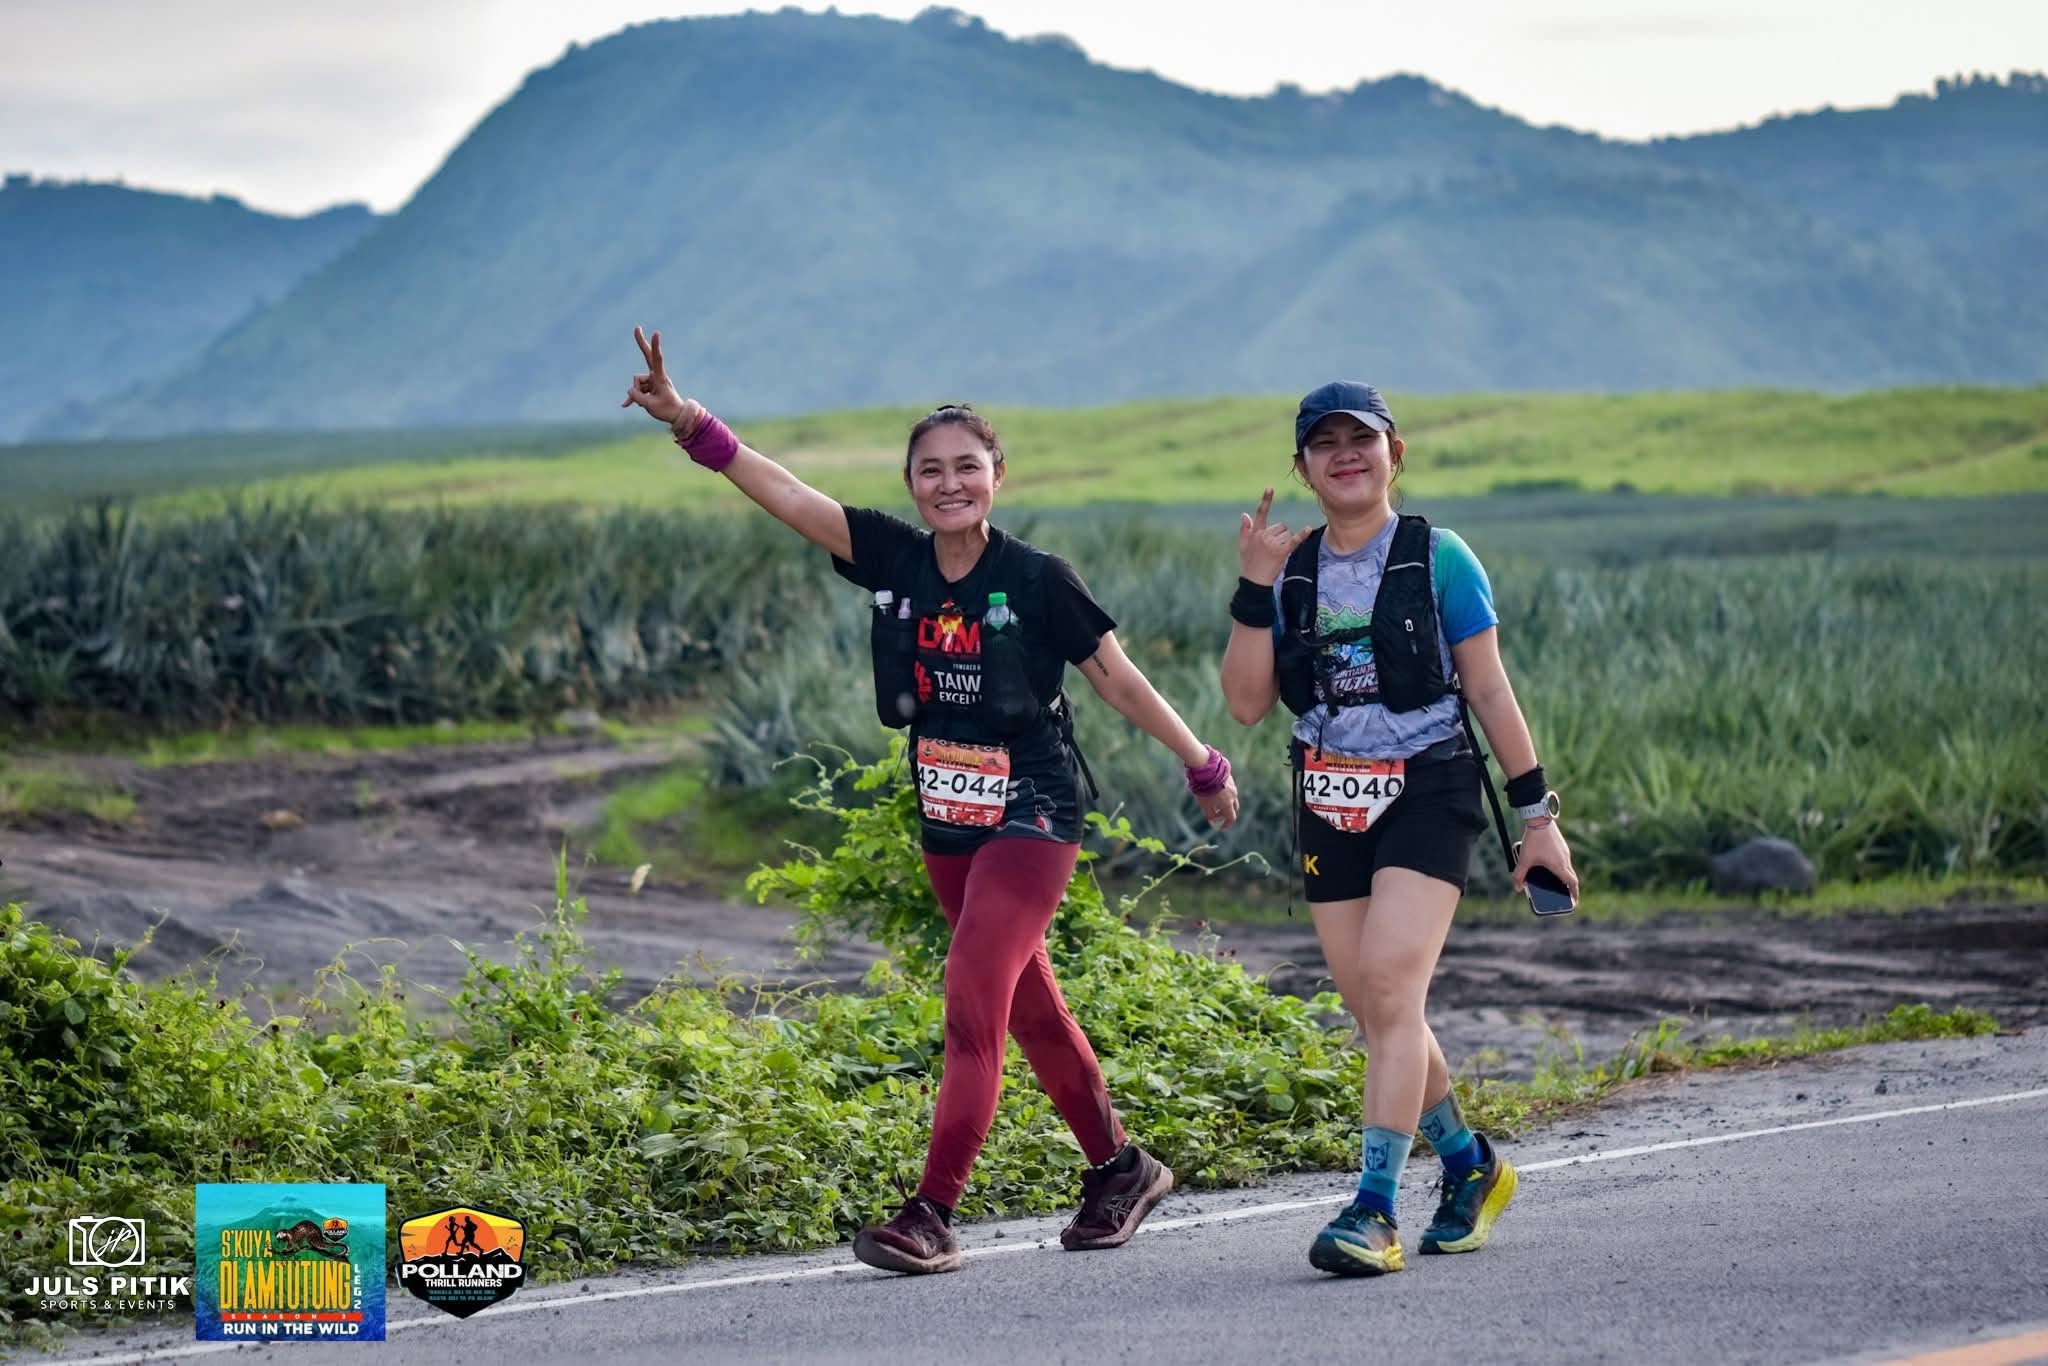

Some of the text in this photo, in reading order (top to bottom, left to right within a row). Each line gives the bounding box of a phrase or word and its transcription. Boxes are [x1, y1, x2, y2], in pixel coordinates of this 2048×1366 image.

[934, 670, 982, 692] TAIW
[1334, 672, 1378, 692] ULTR
[918, 766, 1005, 799] 42-044
[1304, 773, 1403, 799] 42-040
[1303, 853, 1320, 876] K
